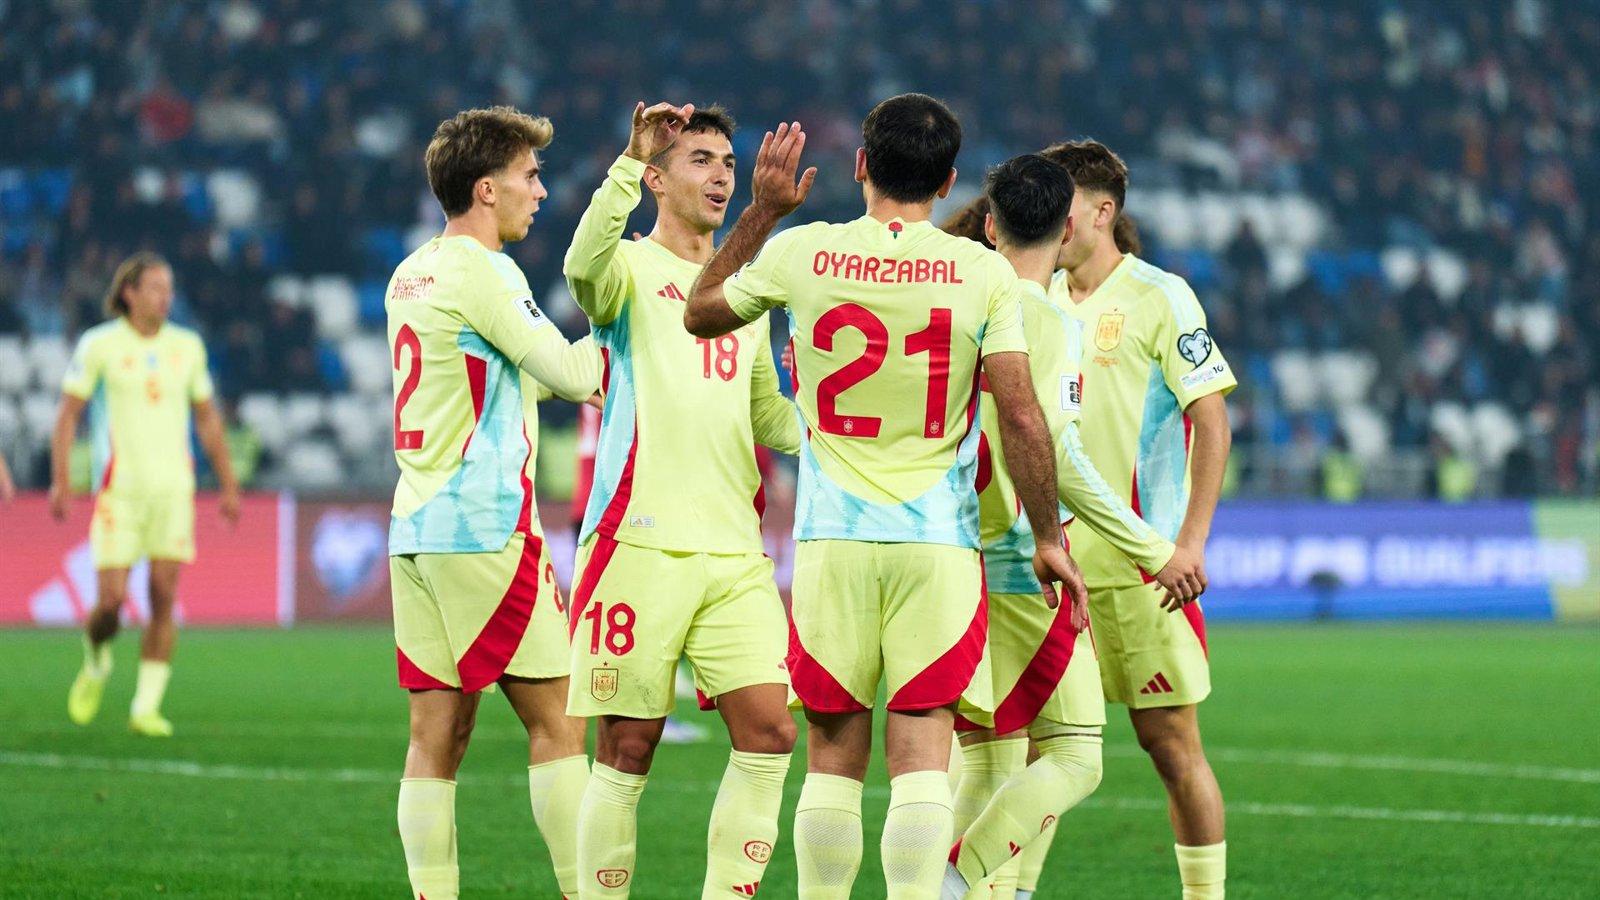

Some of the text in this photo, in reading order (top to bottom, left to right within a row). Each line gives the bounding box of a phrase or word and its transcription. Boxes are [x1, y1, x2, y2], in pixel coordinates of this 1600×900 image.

[813, 250, 963, 284] OYARZABAL
[695, 331, 739, 381] 18
[812, 302, 952, 438] 21
[393, 322, 424, 451] 2
[584, 601, 636, 657] 18
